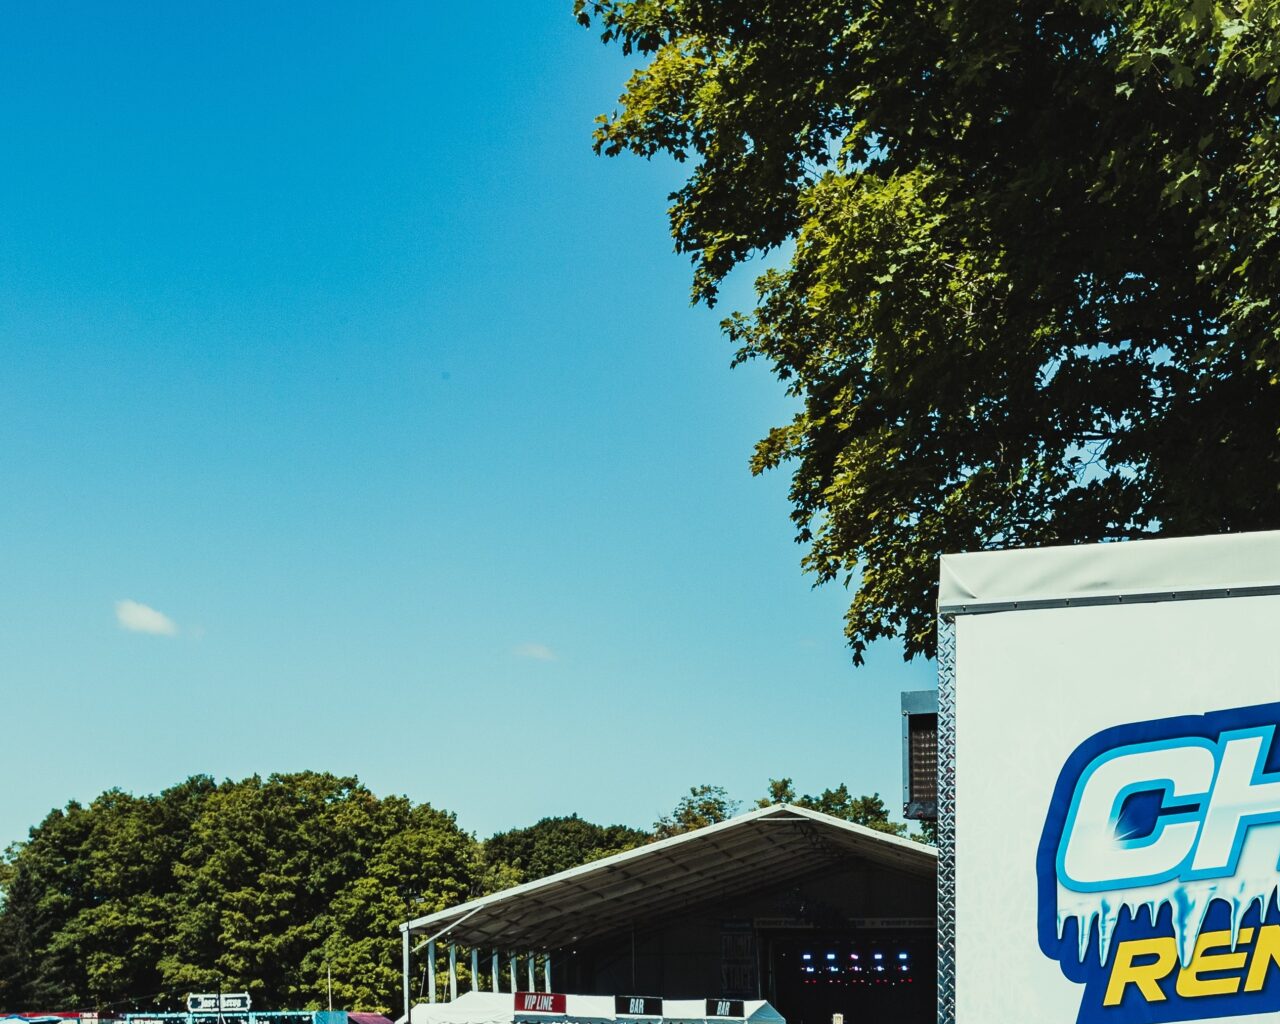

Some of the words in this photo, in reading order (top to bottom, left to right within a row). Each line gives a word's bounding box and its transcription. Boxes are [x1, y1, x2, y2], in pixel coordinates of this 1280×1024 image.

[524, 994, 537, 1010] VIP
[536, 995, 554, 1011] LINE
[629, 998, 644, 1014] BAR
[717, 1001, 730, 1016] BAR
